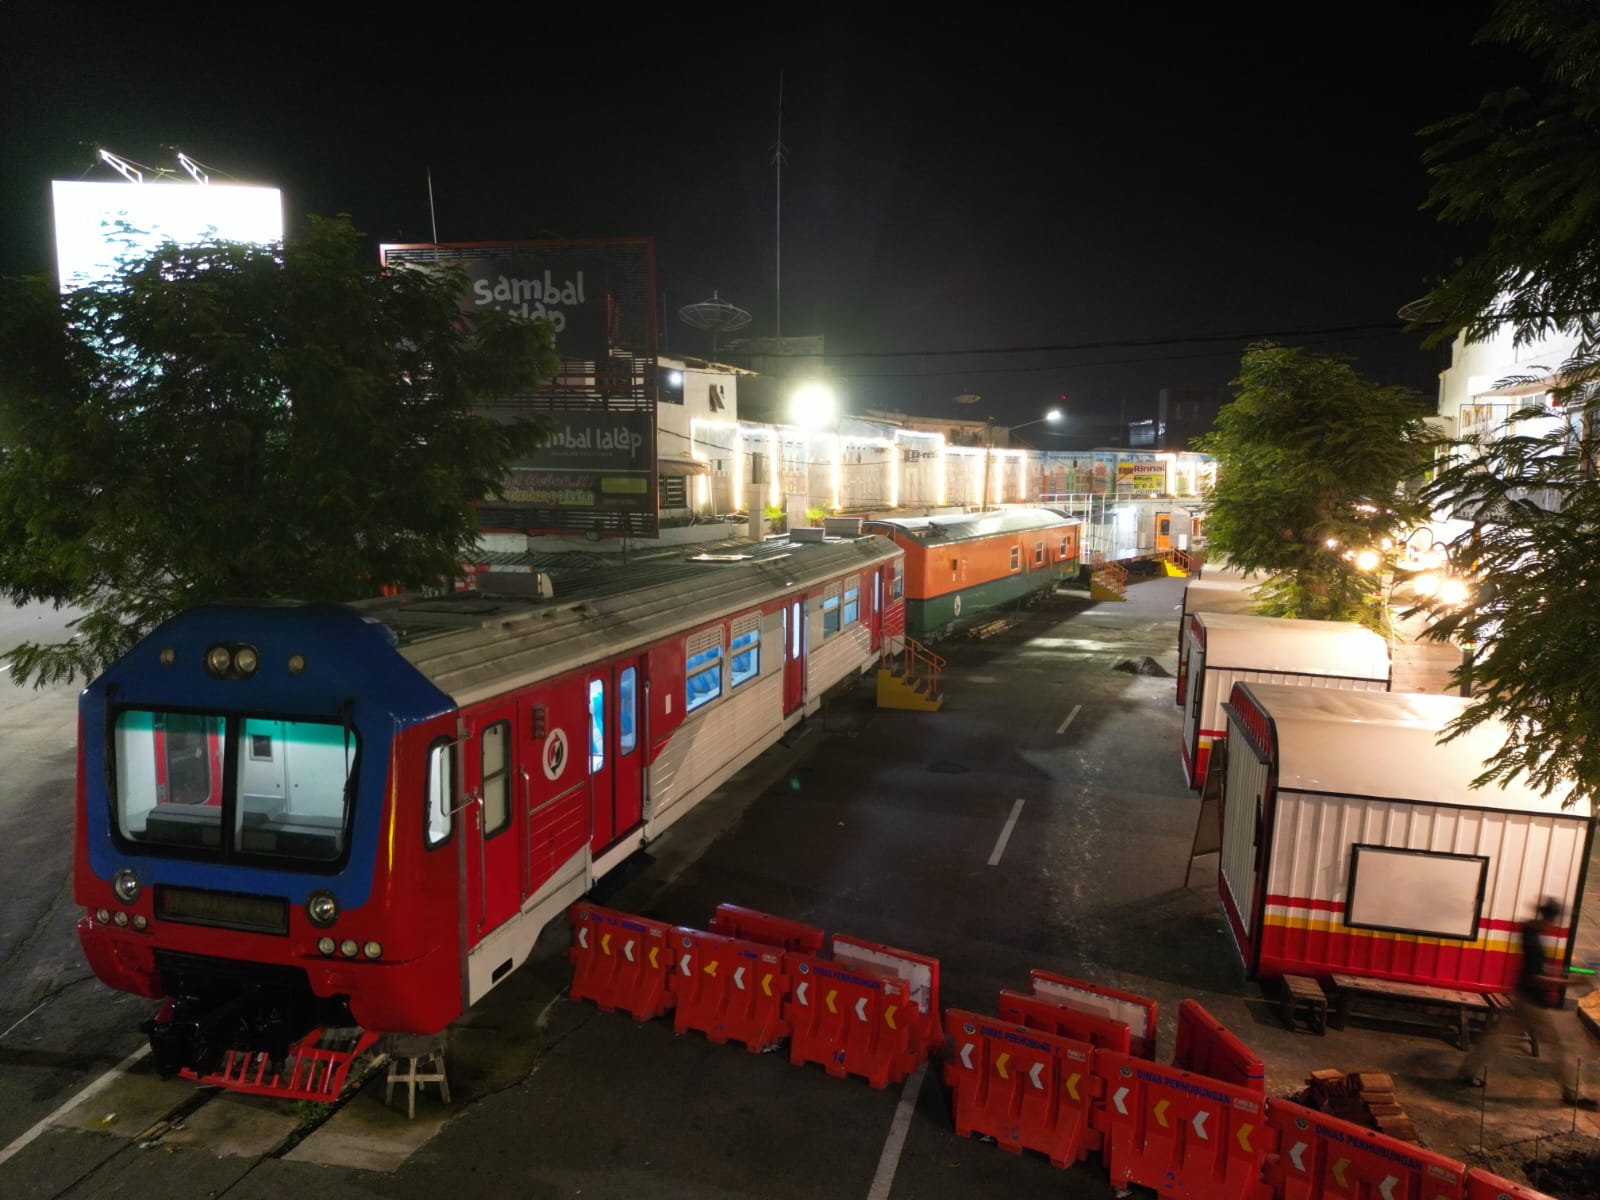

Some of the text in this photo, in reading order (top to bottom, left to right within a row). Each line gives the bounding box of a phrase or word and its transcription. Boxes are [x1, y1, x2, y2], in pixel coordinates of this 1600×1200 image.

[474, 269, 585, 305] sambal
[596, 427, 642, 458] lalap
[1136, 1069, 1231, 1104] DINAS PERHUBUNGAN
[1315, 1123, 1423, 1171] DINAS PERHUBUNGAN
